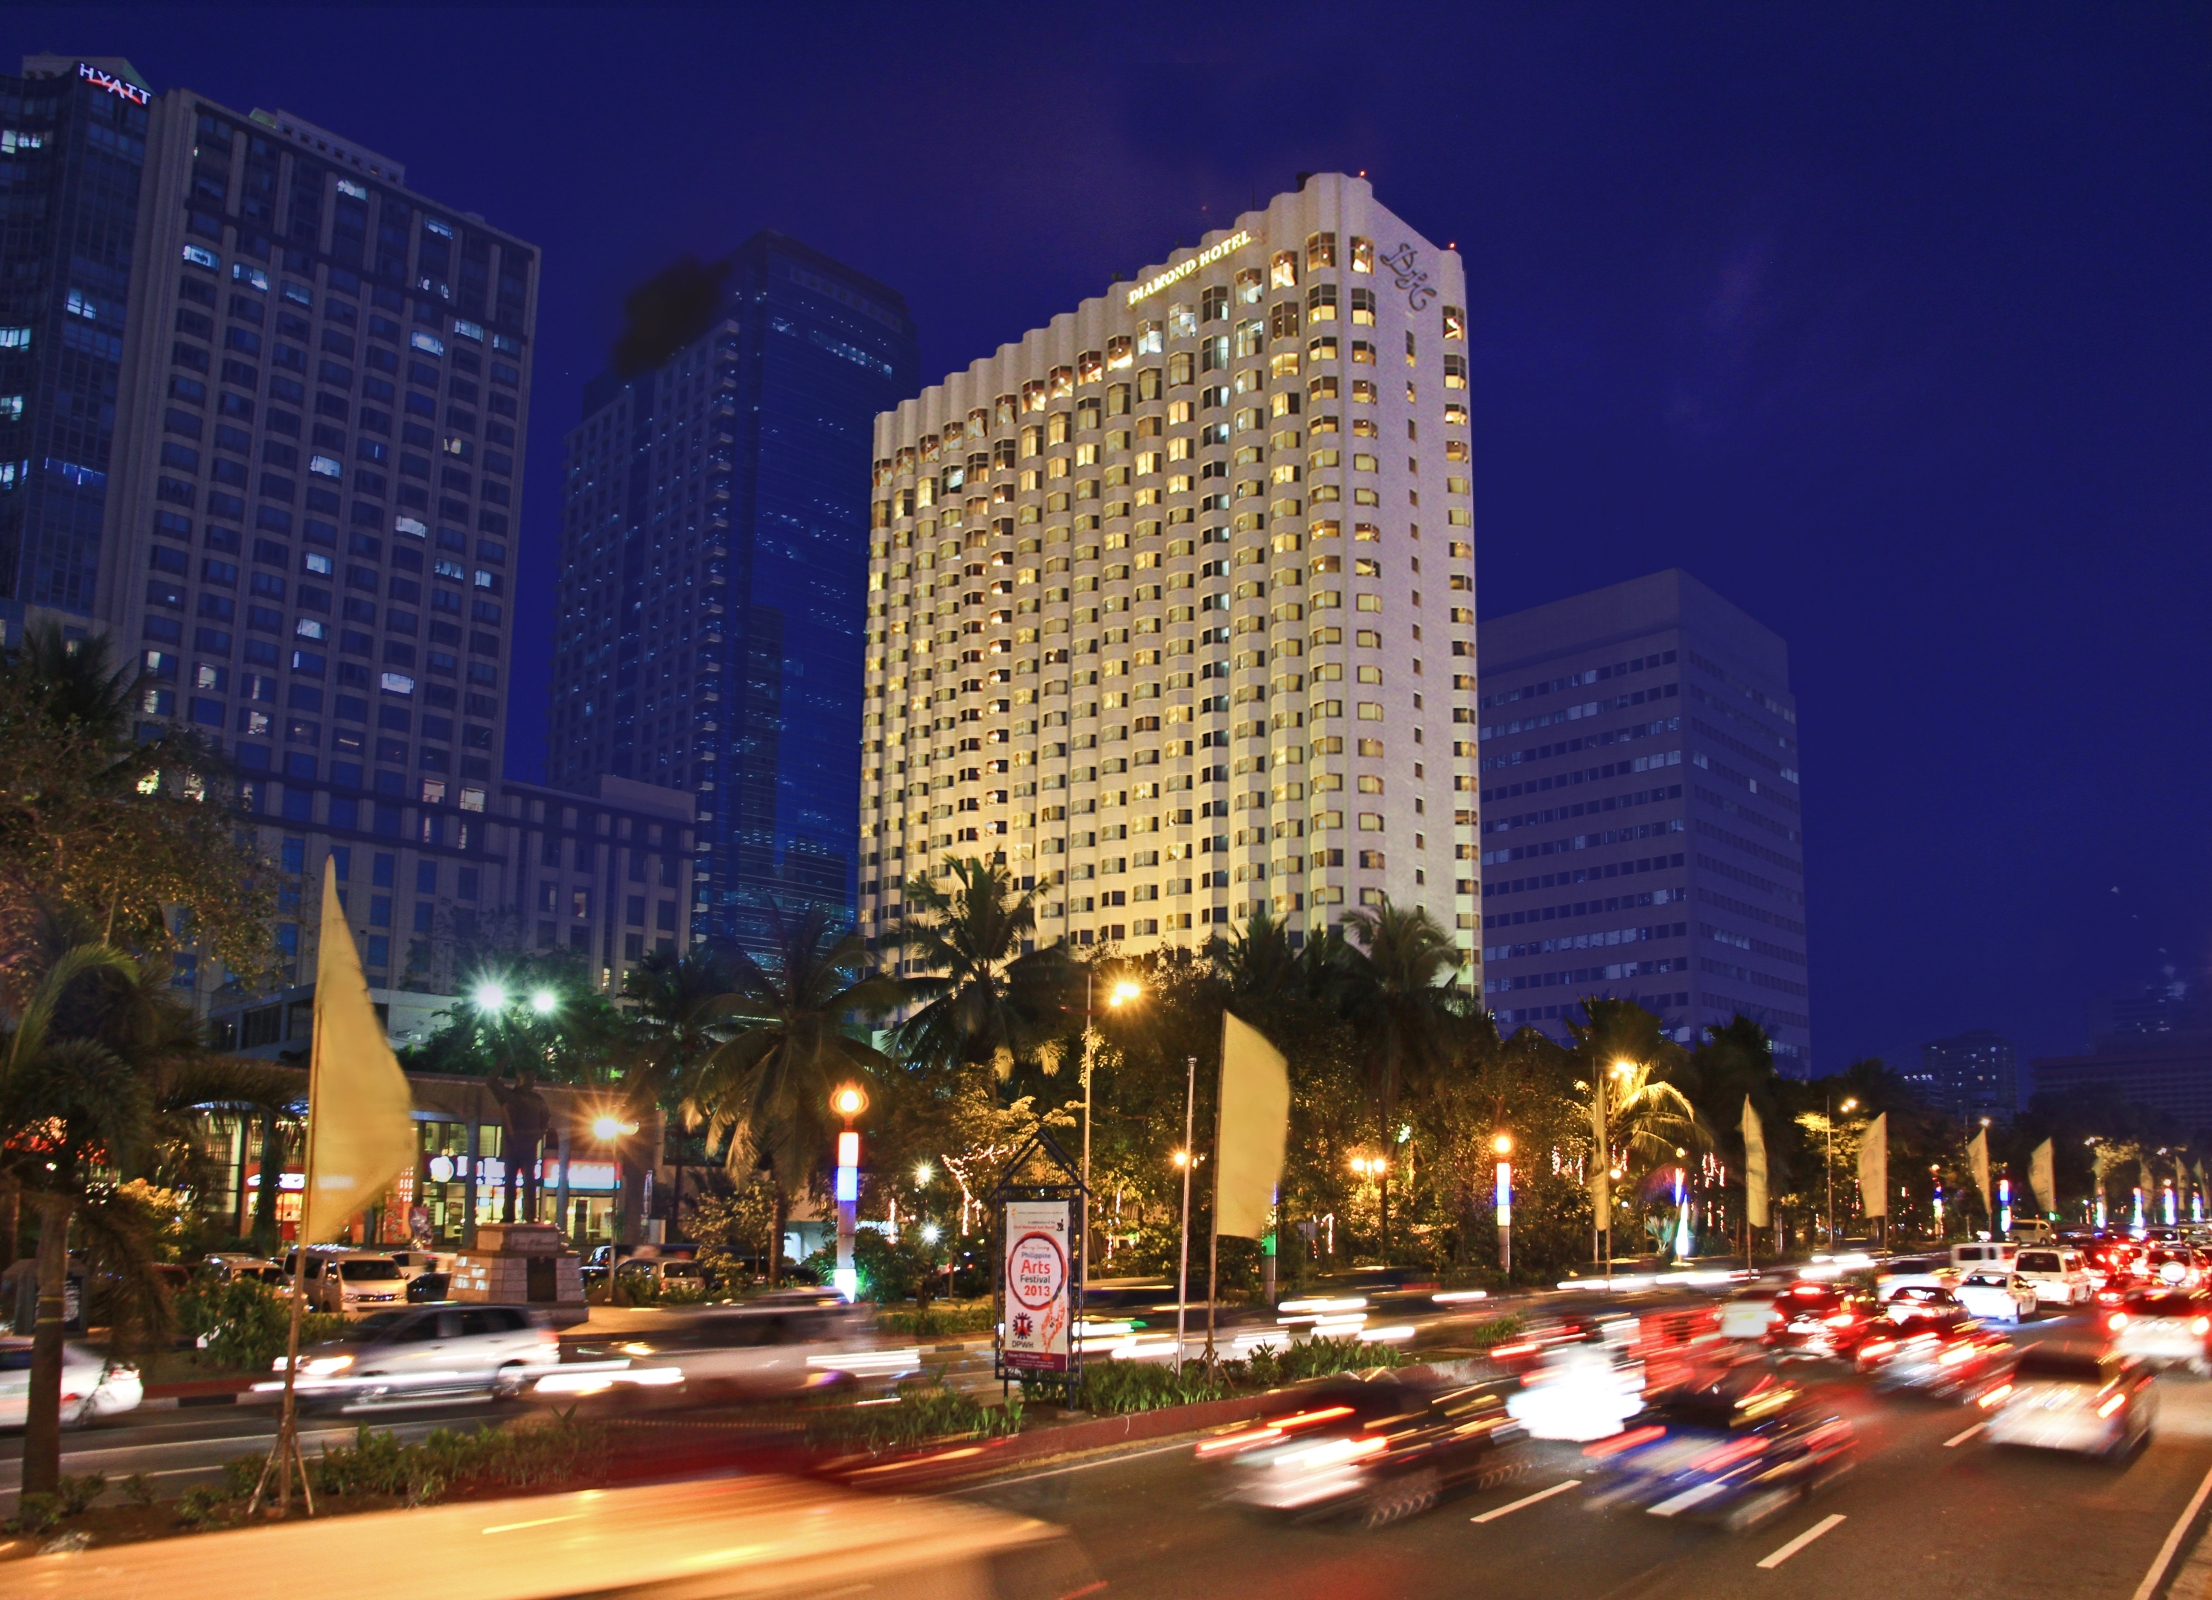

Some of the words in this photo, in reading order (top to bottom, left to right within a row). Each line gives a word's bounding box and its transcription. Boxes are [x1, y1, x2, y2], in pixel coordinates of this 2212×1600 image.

[79, 63, 152, 105] HYATT
[1128, 258, 1197, 305] DIAMOND
[1199, 230, 1252, 268] HOTEL
[1021, 1259, 1051, 1274] Arts
[1020, 1275, 1051, 1284] Festival
[1024, 1285, 1050, 1297] 2013
